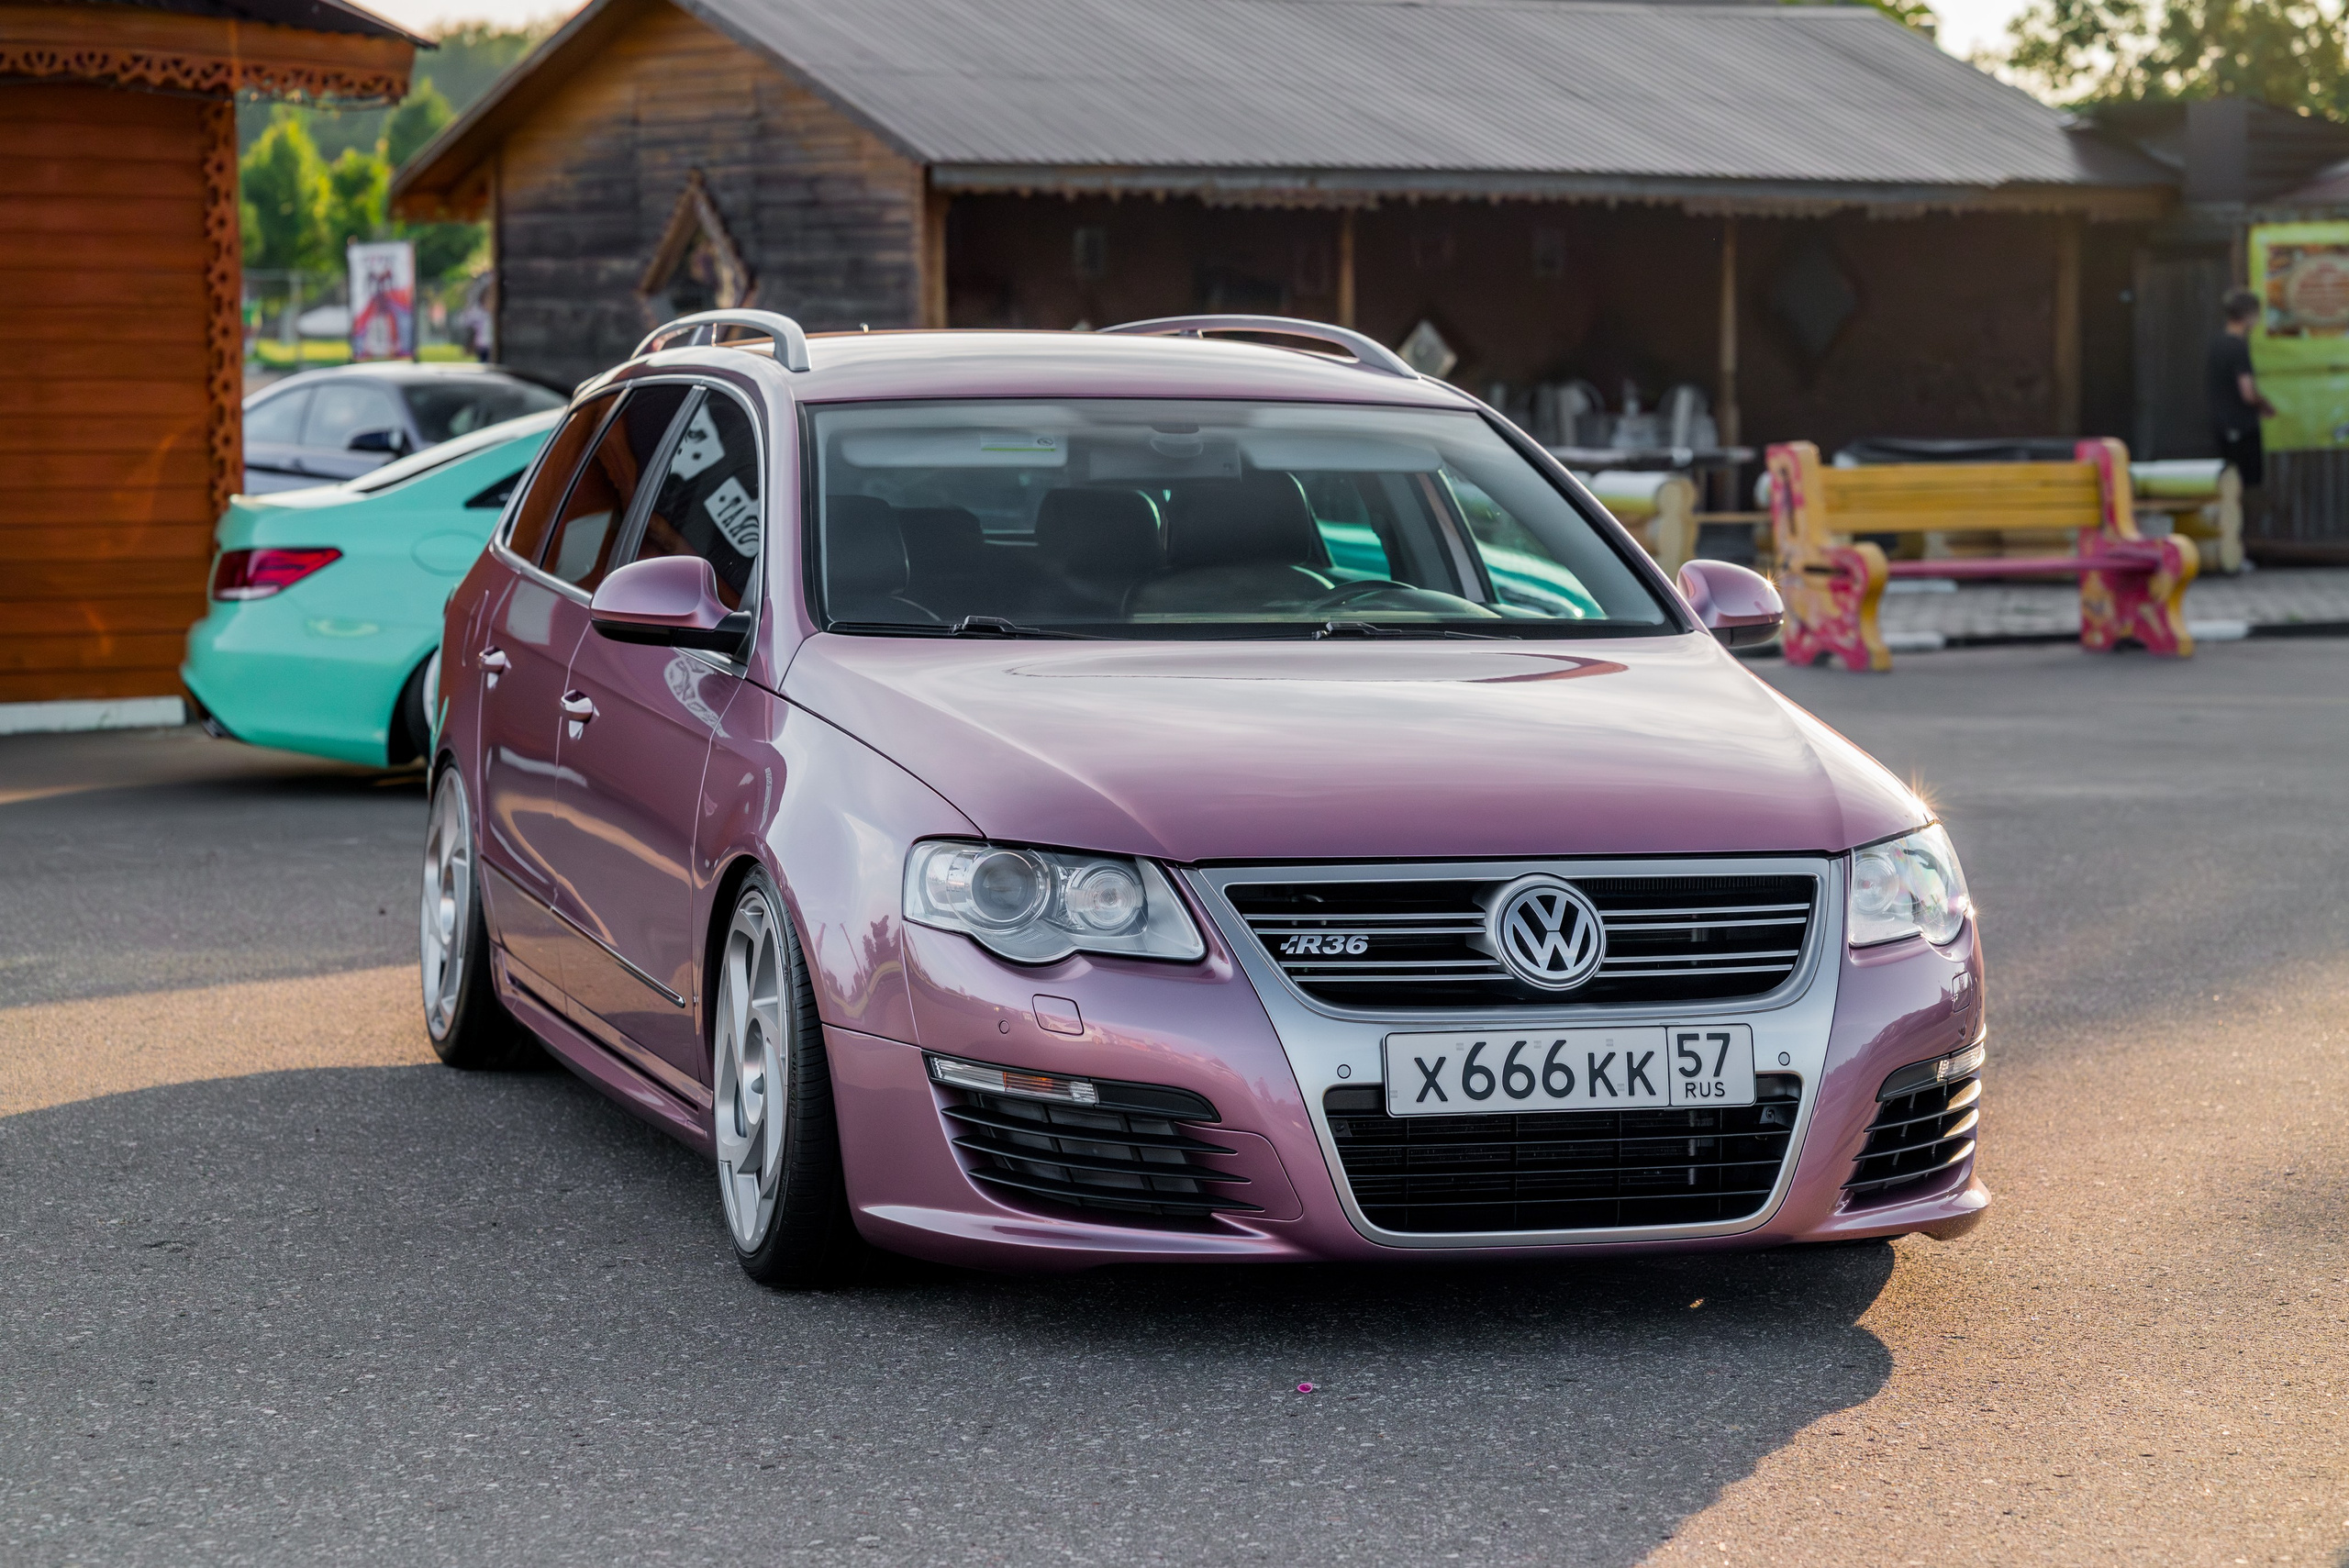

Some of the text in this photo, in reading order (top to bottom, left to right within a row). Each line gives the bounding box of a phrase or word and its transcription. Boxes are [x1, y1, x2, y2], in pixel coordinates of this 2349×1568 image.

[1295, 935, 1369, 955] R36
[1505, 887, 1598, 980] VW
[1676, 1032, 1731, 1077] 57
[1685, 1081, 1726, 1099] RUS
